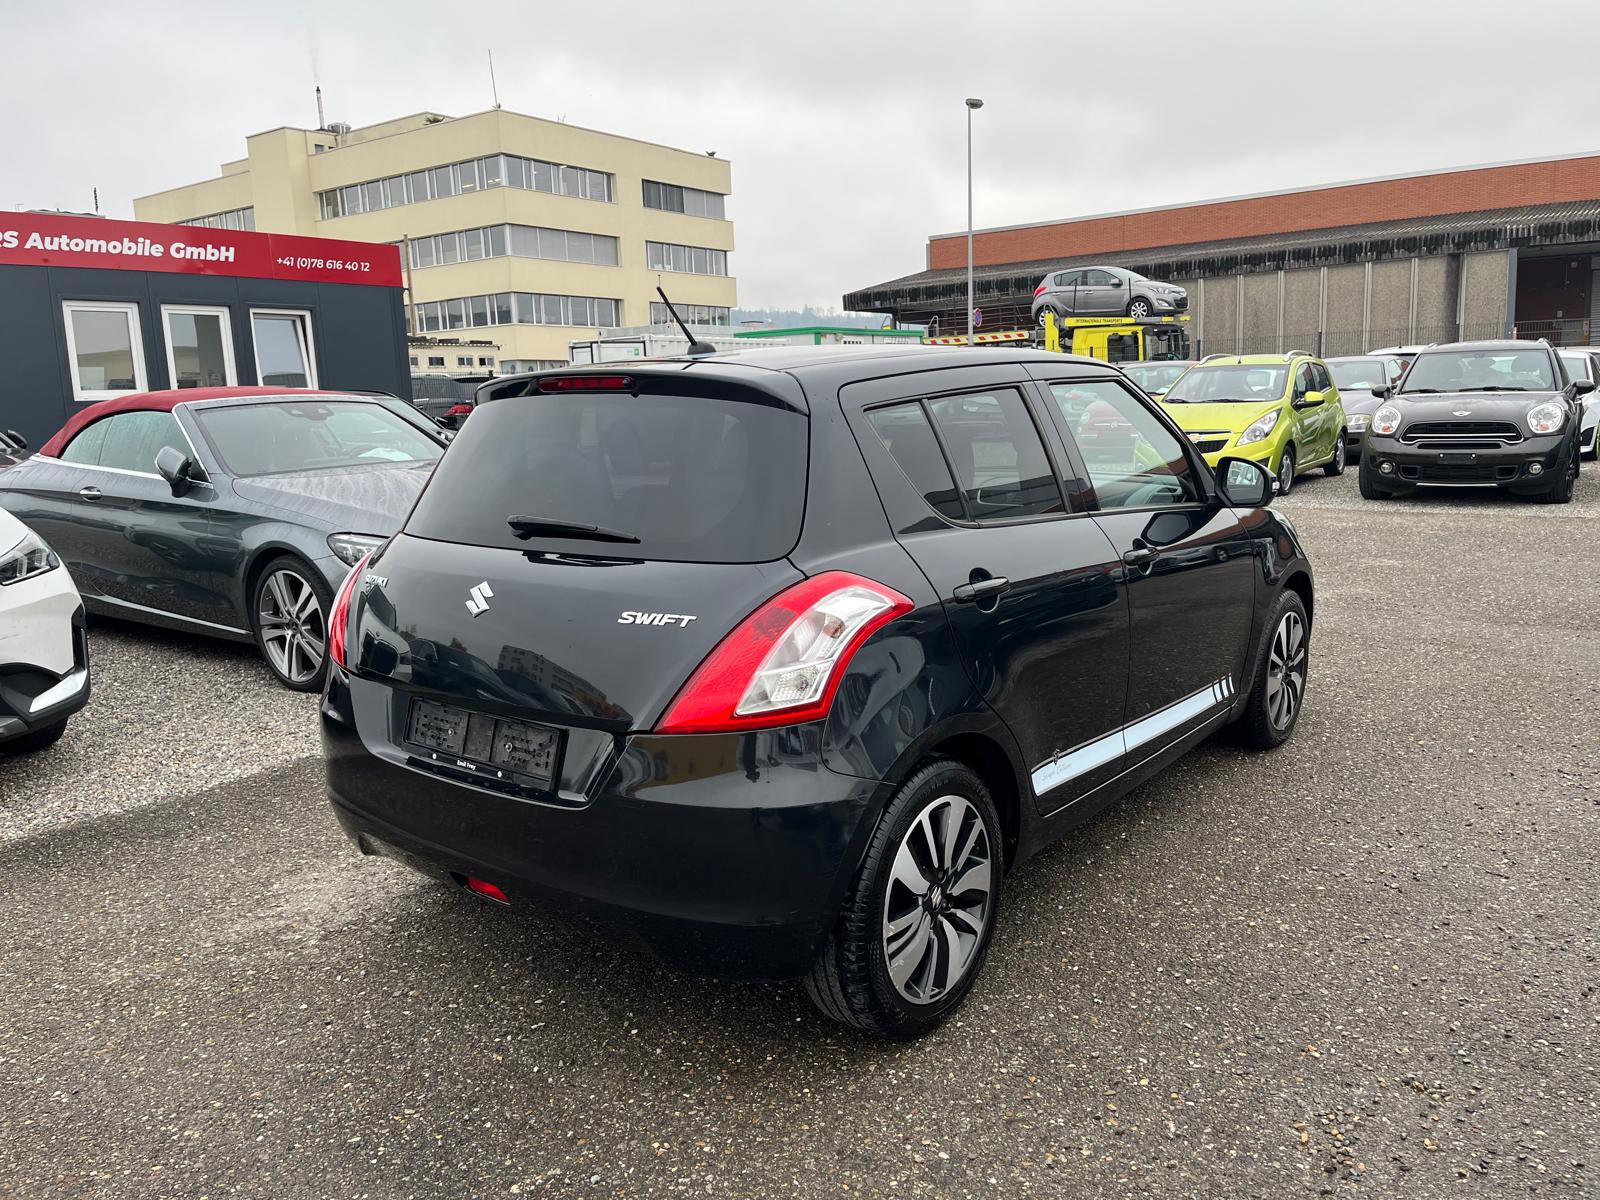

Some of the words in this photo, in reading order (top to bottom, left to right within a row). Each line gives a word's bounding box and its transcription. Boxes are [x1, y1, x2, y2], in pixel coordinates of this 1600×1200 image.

[0, 231, 19, 249] S
[24, 232, 164, 257] Automobile
[170, 242, 235, 262] GmbH
[277, 256, 294, 267] +41
[297, 257, 324, 270] (0)78
[326, 259, 343, 270] 616
[345, 261, 359, 271] 40
[360, 262, 370, 272] 12
[617, 611, 697, 628] SWIFT
